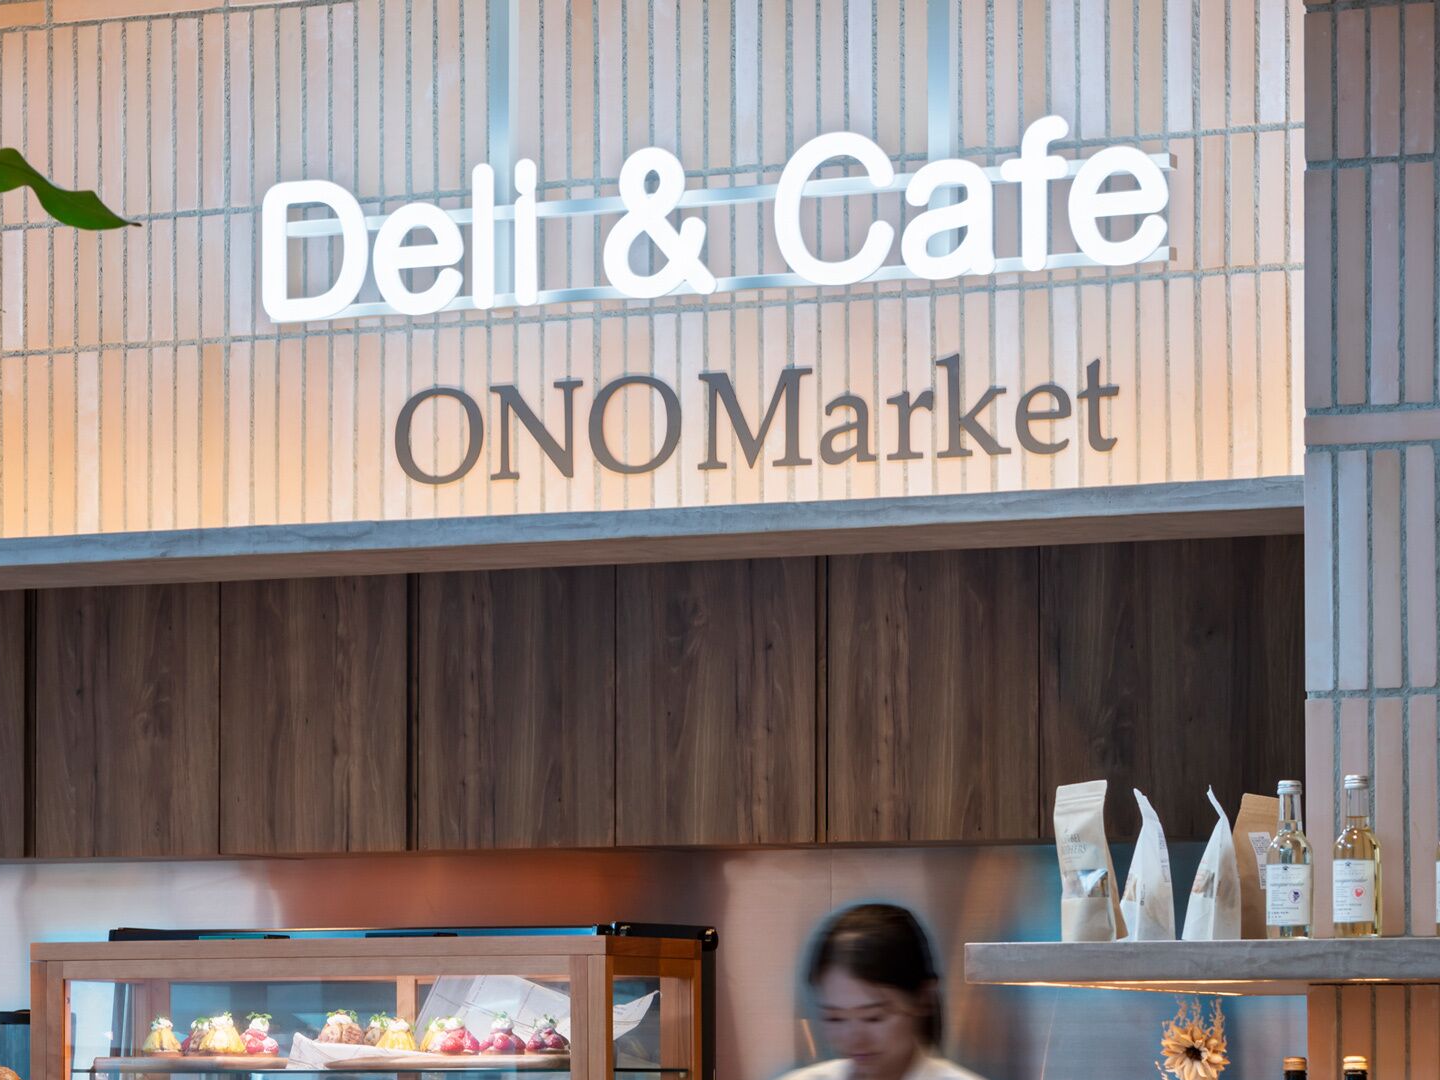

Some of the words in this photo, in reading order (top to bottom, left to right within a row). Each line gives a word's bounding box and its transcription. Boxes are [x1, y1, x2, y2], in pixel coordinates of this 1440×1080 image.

[262, 157, 538, 322] Deli
[603, 147, 717, 298] &
[774, 115, 1169, 286] Cafe
